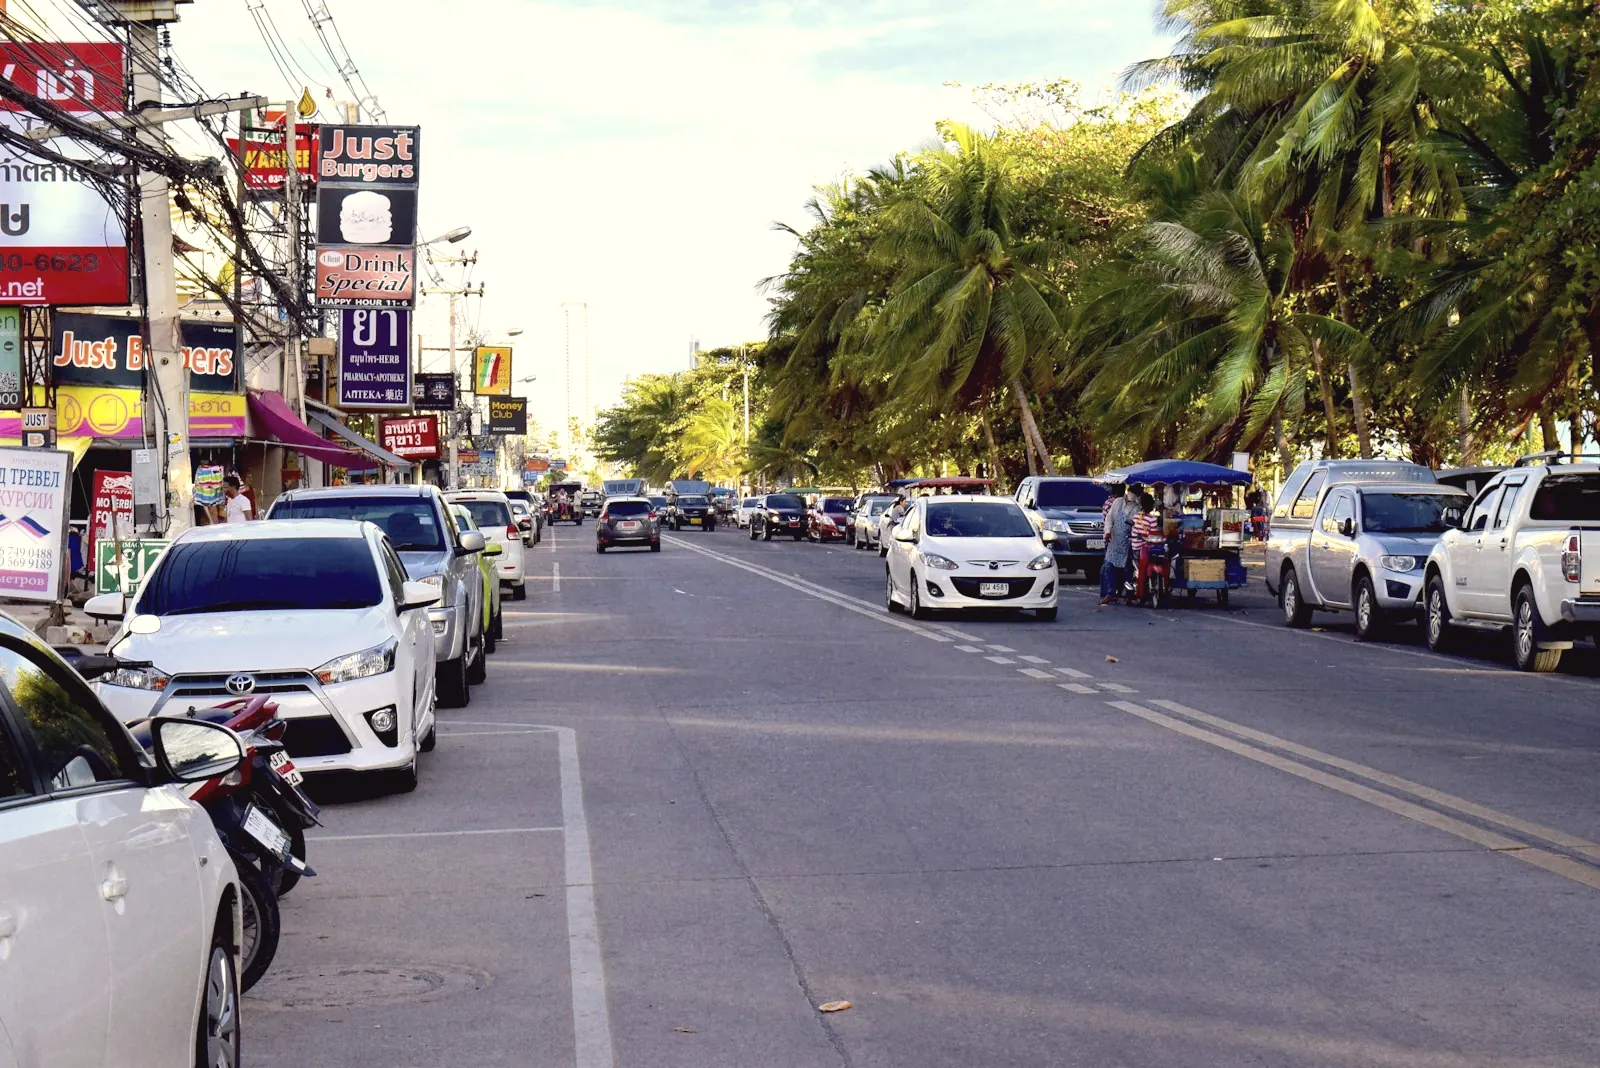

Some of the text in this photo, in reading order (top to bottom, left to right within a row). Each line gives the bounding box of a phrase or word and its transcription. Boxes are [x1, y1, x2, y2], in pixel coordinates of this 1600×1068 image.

[324, 129, 413, 160] Just
[321, 159, 414, 182] Burgers
[345, 254, 409, 272] Drink
[0, 277, 45, 297] .net
[321, 273, 410, 296] Special
[321, 298, 351, 306] HAPPY
[355, 299, 383, 307] HOUR
[352, 309, 397, 347] ยา
[54, 330, 233, 376] Just Bers
[492, 402, 523, 411] Money
[25, 414, 47, 426] JUST
[492, 411, 513, 419] Club
[418, 421, 429, 433] 10
[414, 434, 422, 446] 3
[10, 468, 60, 488] ТРЕВЕЛ
[28, 548, 52, 559] 0488
[28, 559, 52, 570] 9189
